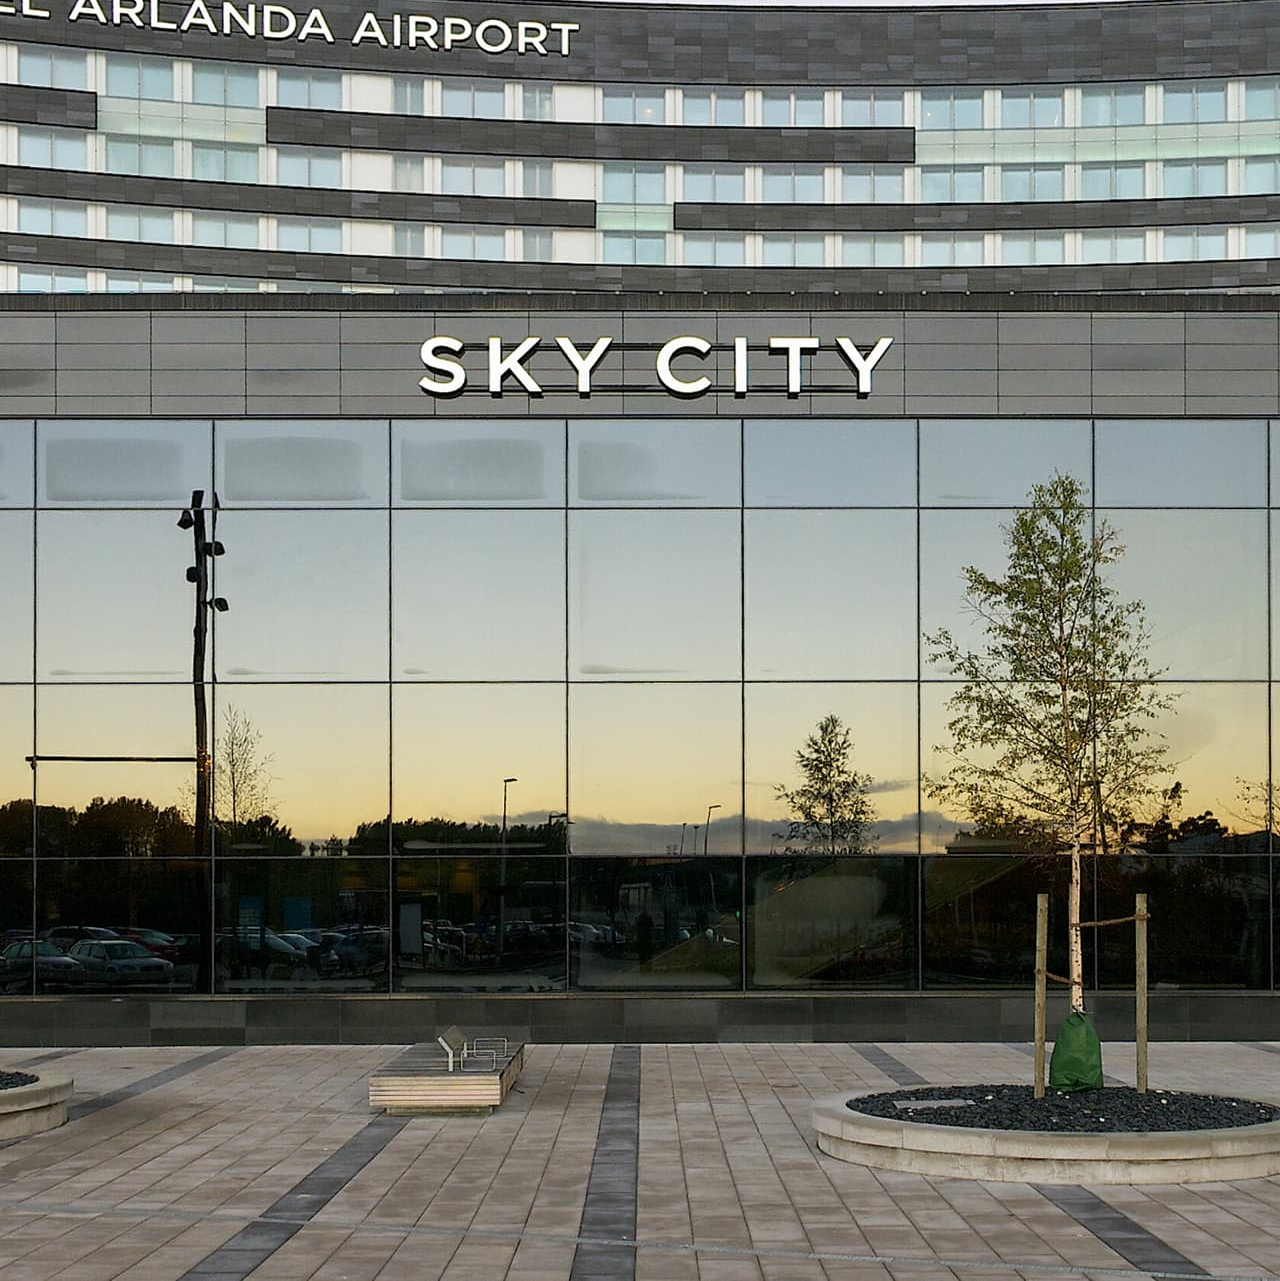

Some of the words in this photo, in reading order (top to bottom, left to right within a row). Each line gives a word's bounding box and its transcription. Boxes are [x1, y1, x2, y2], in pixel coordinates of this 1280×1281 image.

[351, 11, 581, 57] AIRPORT
[418, 334, 615, 396] SKY
[654, 334, 897, 396] CITY
